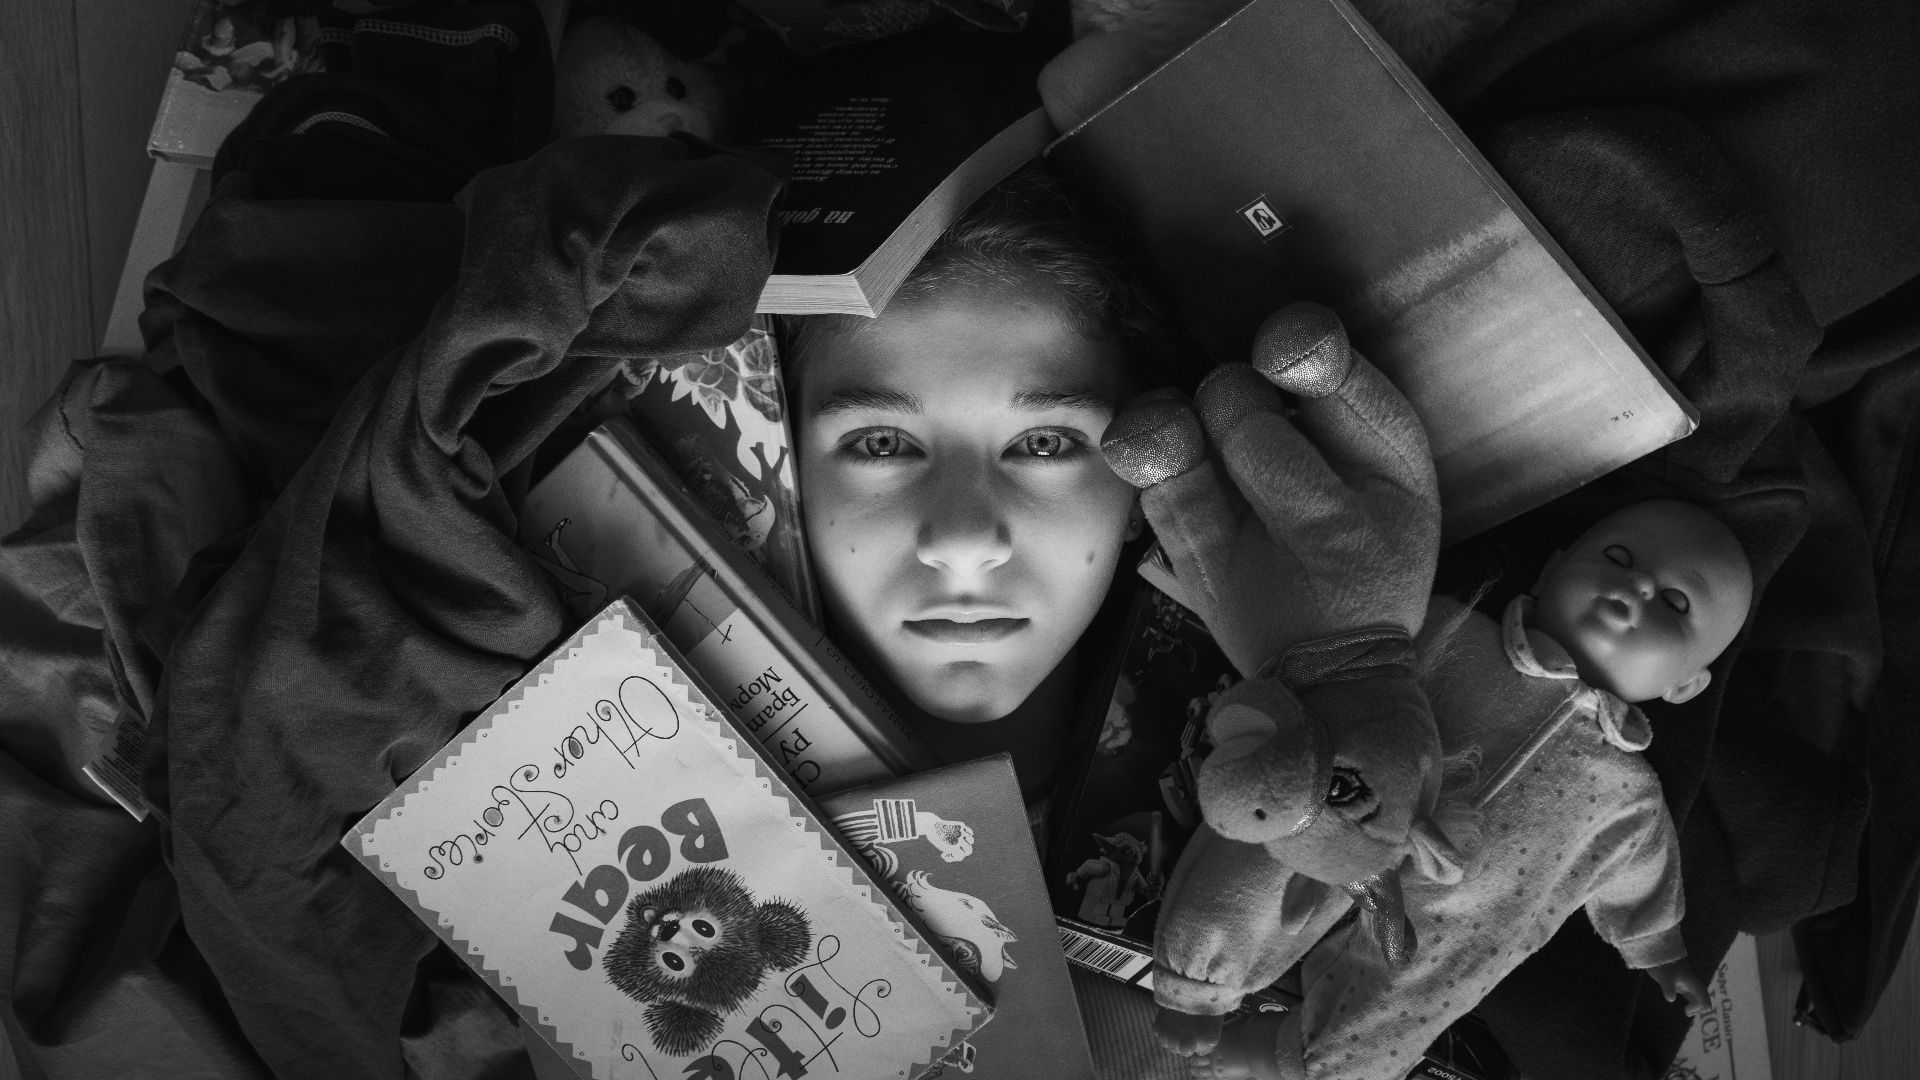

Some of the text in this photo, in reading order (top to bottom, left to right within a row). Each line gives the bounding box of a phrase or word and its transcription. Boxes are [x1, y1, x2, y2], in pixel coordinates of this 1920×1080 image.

[1622, 409, 1634, 419] 15
[424, 675, 680, 880] Other Stories
[772, 728, 812, 766] РУ
[551, 799, 619, 876] and
[549, 797, 730, 971] Bear
[682, 935, 892, 1080] Little
[1700, 990, 1721, 1054] ICE
